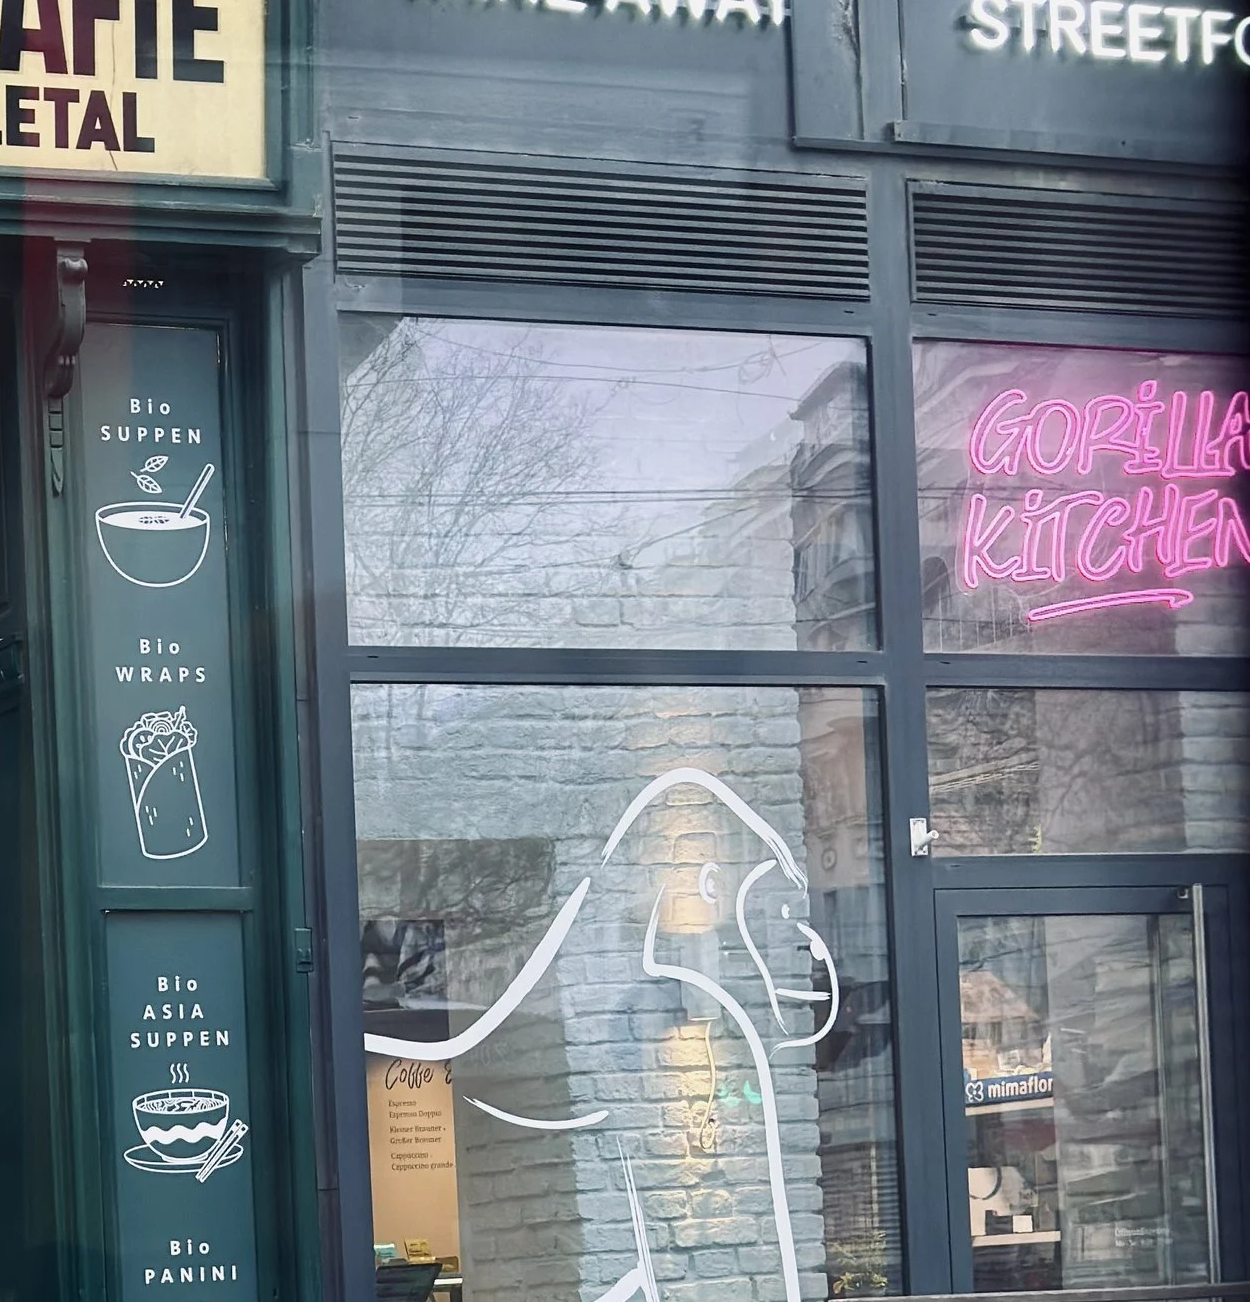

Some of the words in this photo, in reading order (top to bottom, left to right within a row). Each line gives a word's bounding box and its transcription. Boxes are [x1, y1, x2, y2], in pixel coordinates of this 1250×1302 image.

[130, 398, 172, 415] Bio
[100, 424, 203, 445] SUPPEN
[139, 638, 180, 655] Bio
[116, 666, 207, 684] WRAPS
[157, 976, 199, 992] Bio
[143, 1004, 205, 1020] ASIA
[130, 1029, 231, 1048] SUPPEN
[988, 1076, 1053, 1098] mimaflor
[170, 1240, 210, 1256] Bio
[144, 1265, 238, 1285] PANINI
